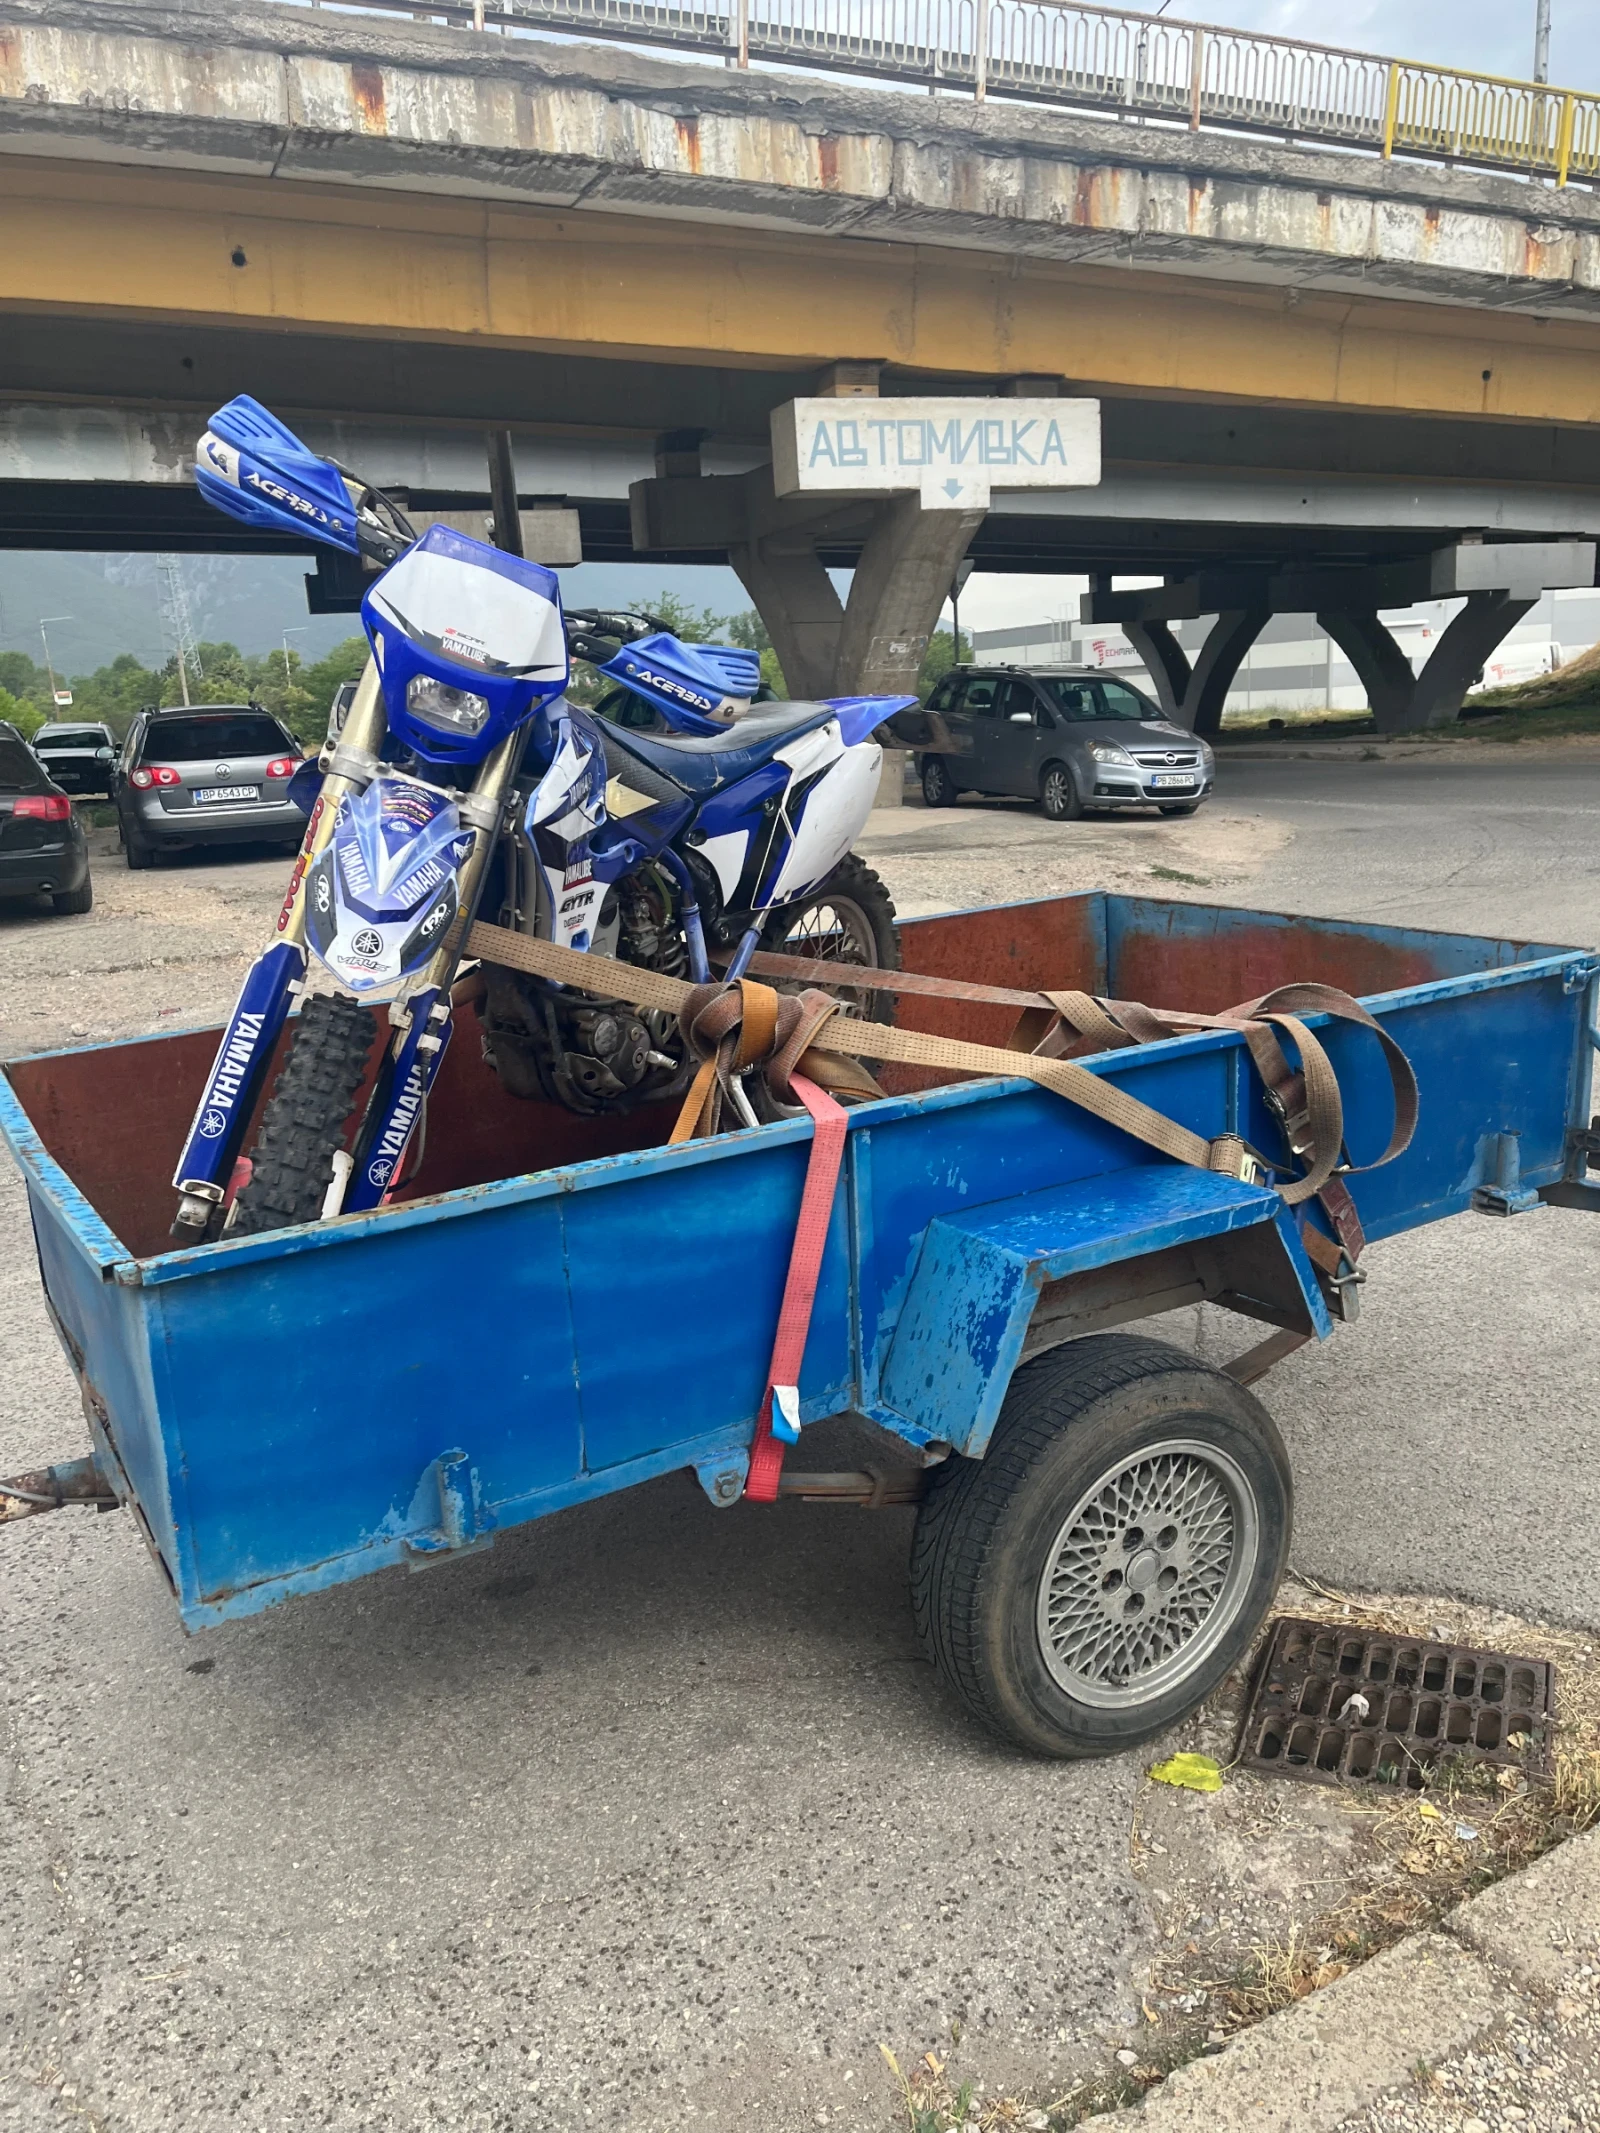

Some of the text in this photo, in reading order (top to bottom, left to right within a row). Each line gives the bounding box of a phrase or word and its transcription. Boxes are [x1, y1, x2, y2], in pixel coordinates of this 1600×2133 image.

[808, 418, 1068, 468] АВТОМИВКА
[442, 636, 487, 664] YAMALUBE
[202, 787, 255, 800] BP 6543 CP
[338, 840, 372, 897] YAMAHA
[392, 860, 445, 908] YAMAHA
[558, 888, 595, 914] GYTR
[209, 1012, 266, 1109] YAMAHA
